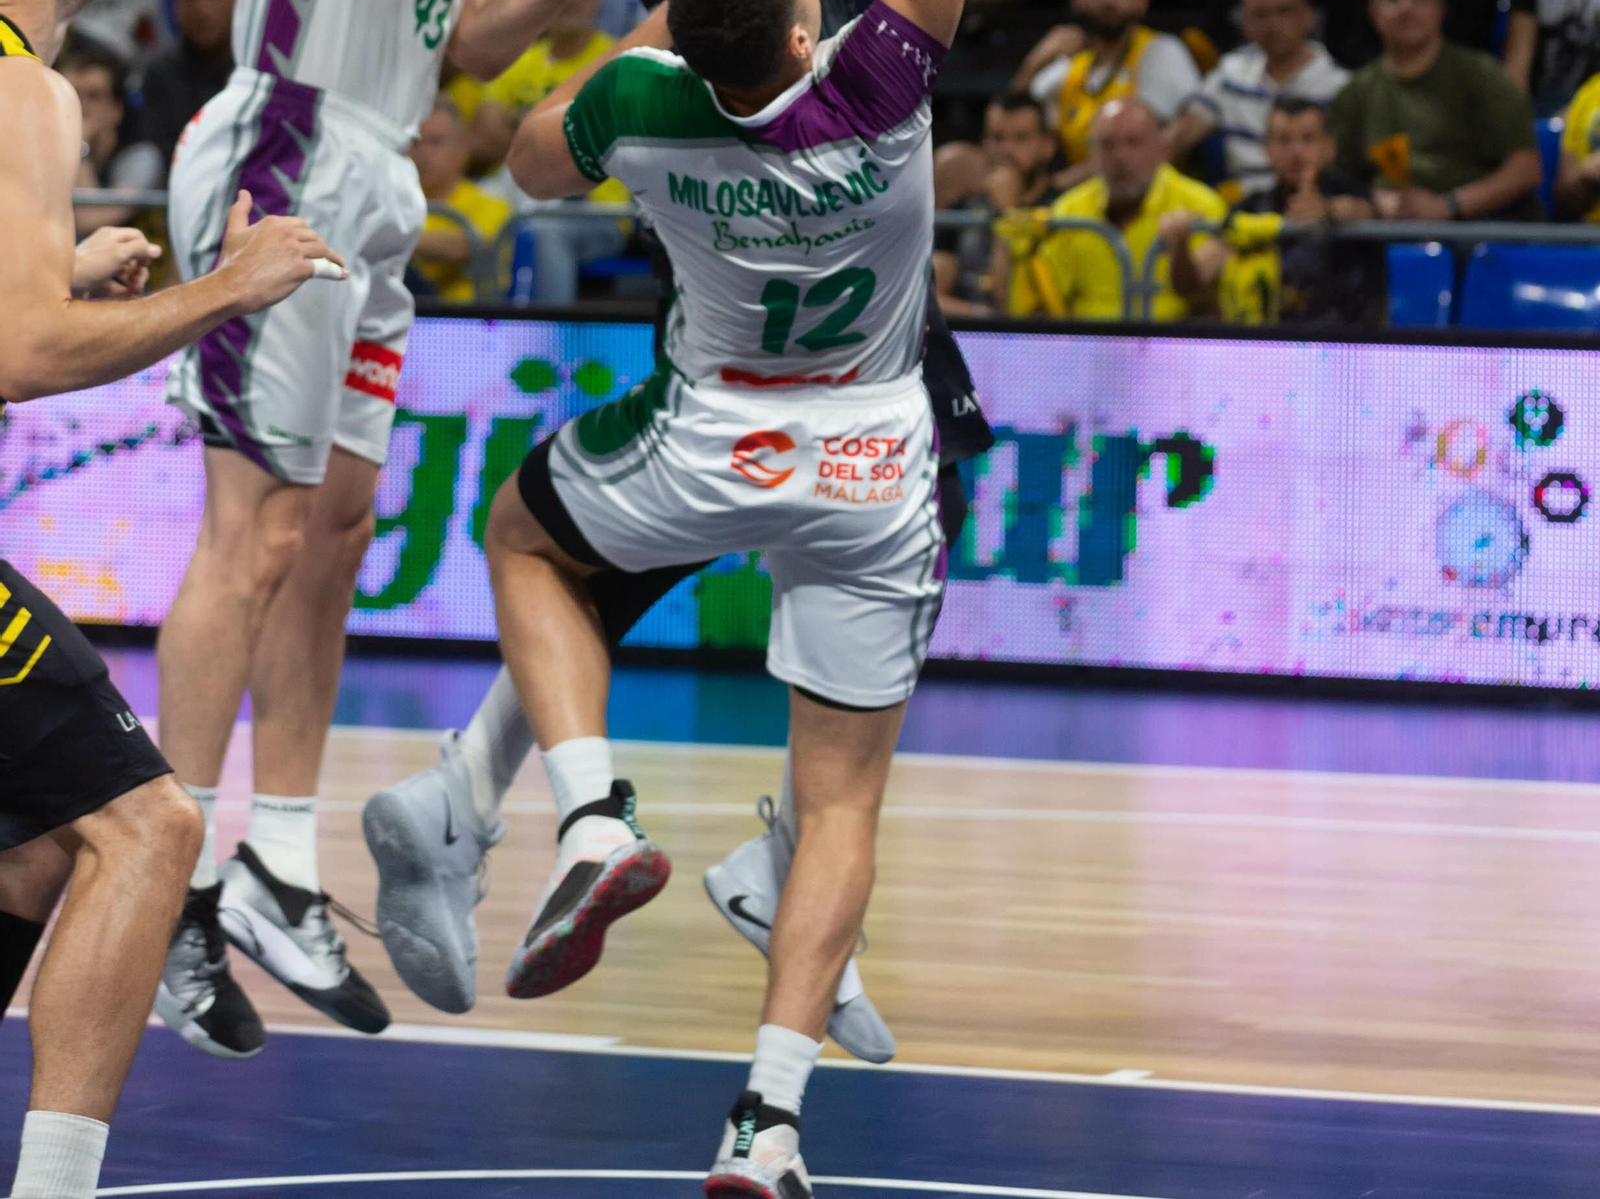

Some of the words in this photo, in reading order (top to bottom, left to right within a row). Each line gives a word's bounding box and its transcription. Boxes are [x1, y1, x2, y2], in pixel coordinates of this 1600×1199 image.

[760, 266, 877, 355] 12
[822, 436, 907, 458] COSTA
[818, 460, 863, 482] DEL
